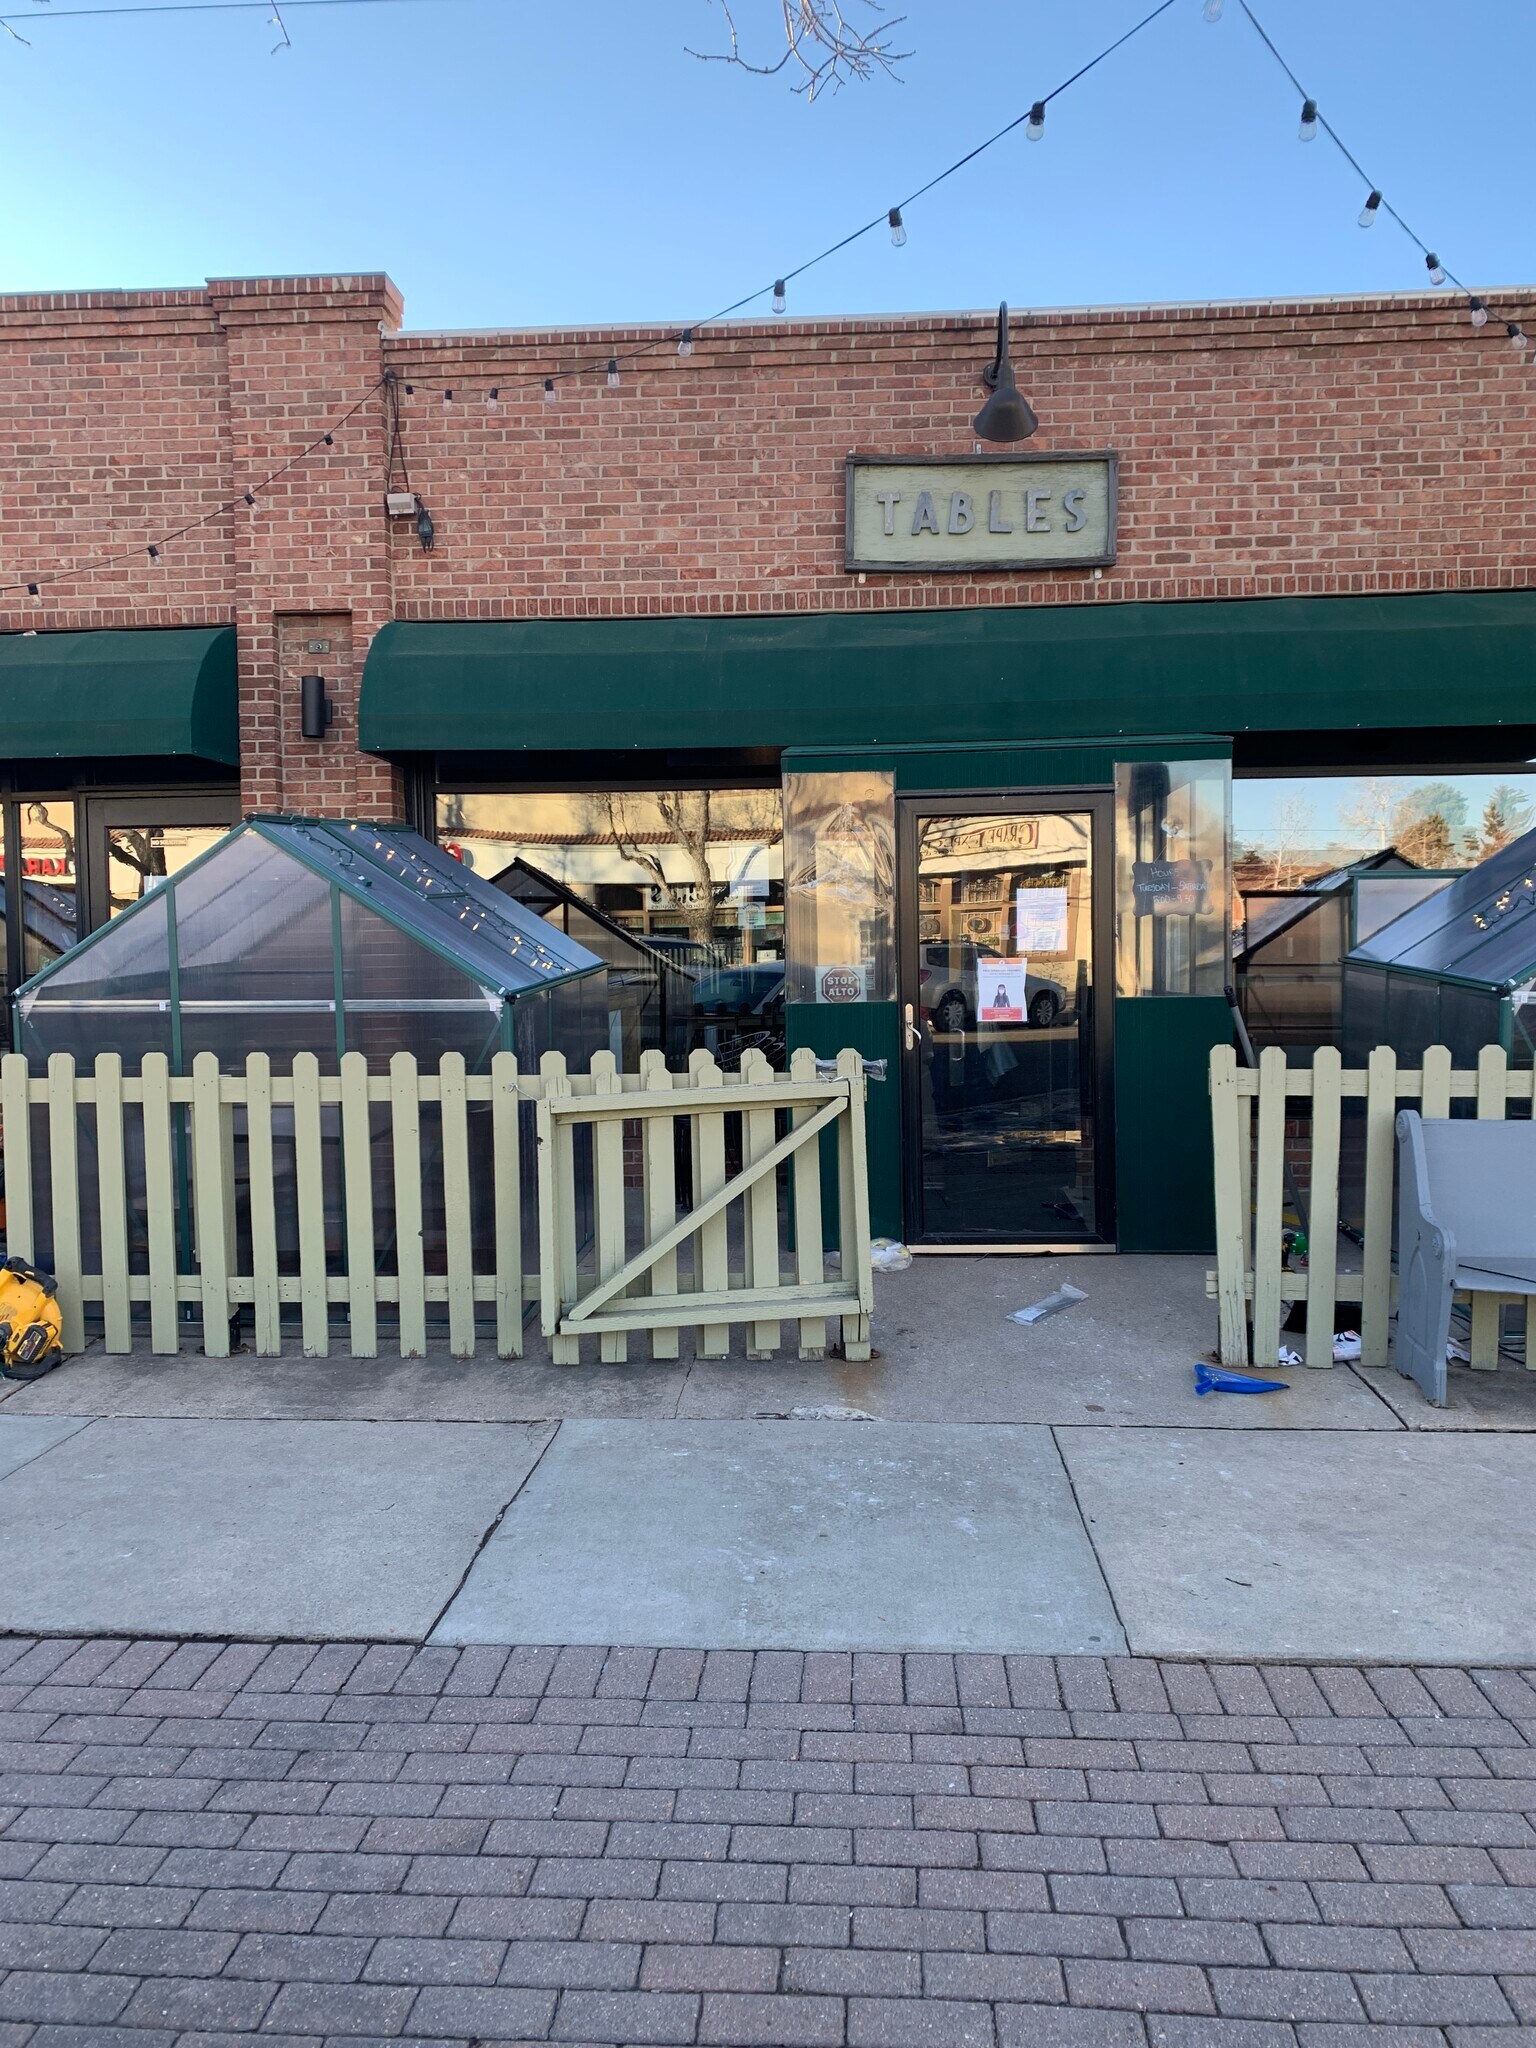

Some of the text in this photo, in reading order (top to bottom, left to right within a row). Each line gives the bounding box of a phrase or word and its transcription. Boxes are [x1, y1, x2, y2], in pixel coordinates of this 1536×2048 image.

[876, 488, 1088, 536] TABLES
[1136, 882, 1170, 892] TUESDAY
[1178, 881, 1208, 892] SATURDA
[827, 976, 855, 985] STOP
[828, 988, 854, 996] ALTO
